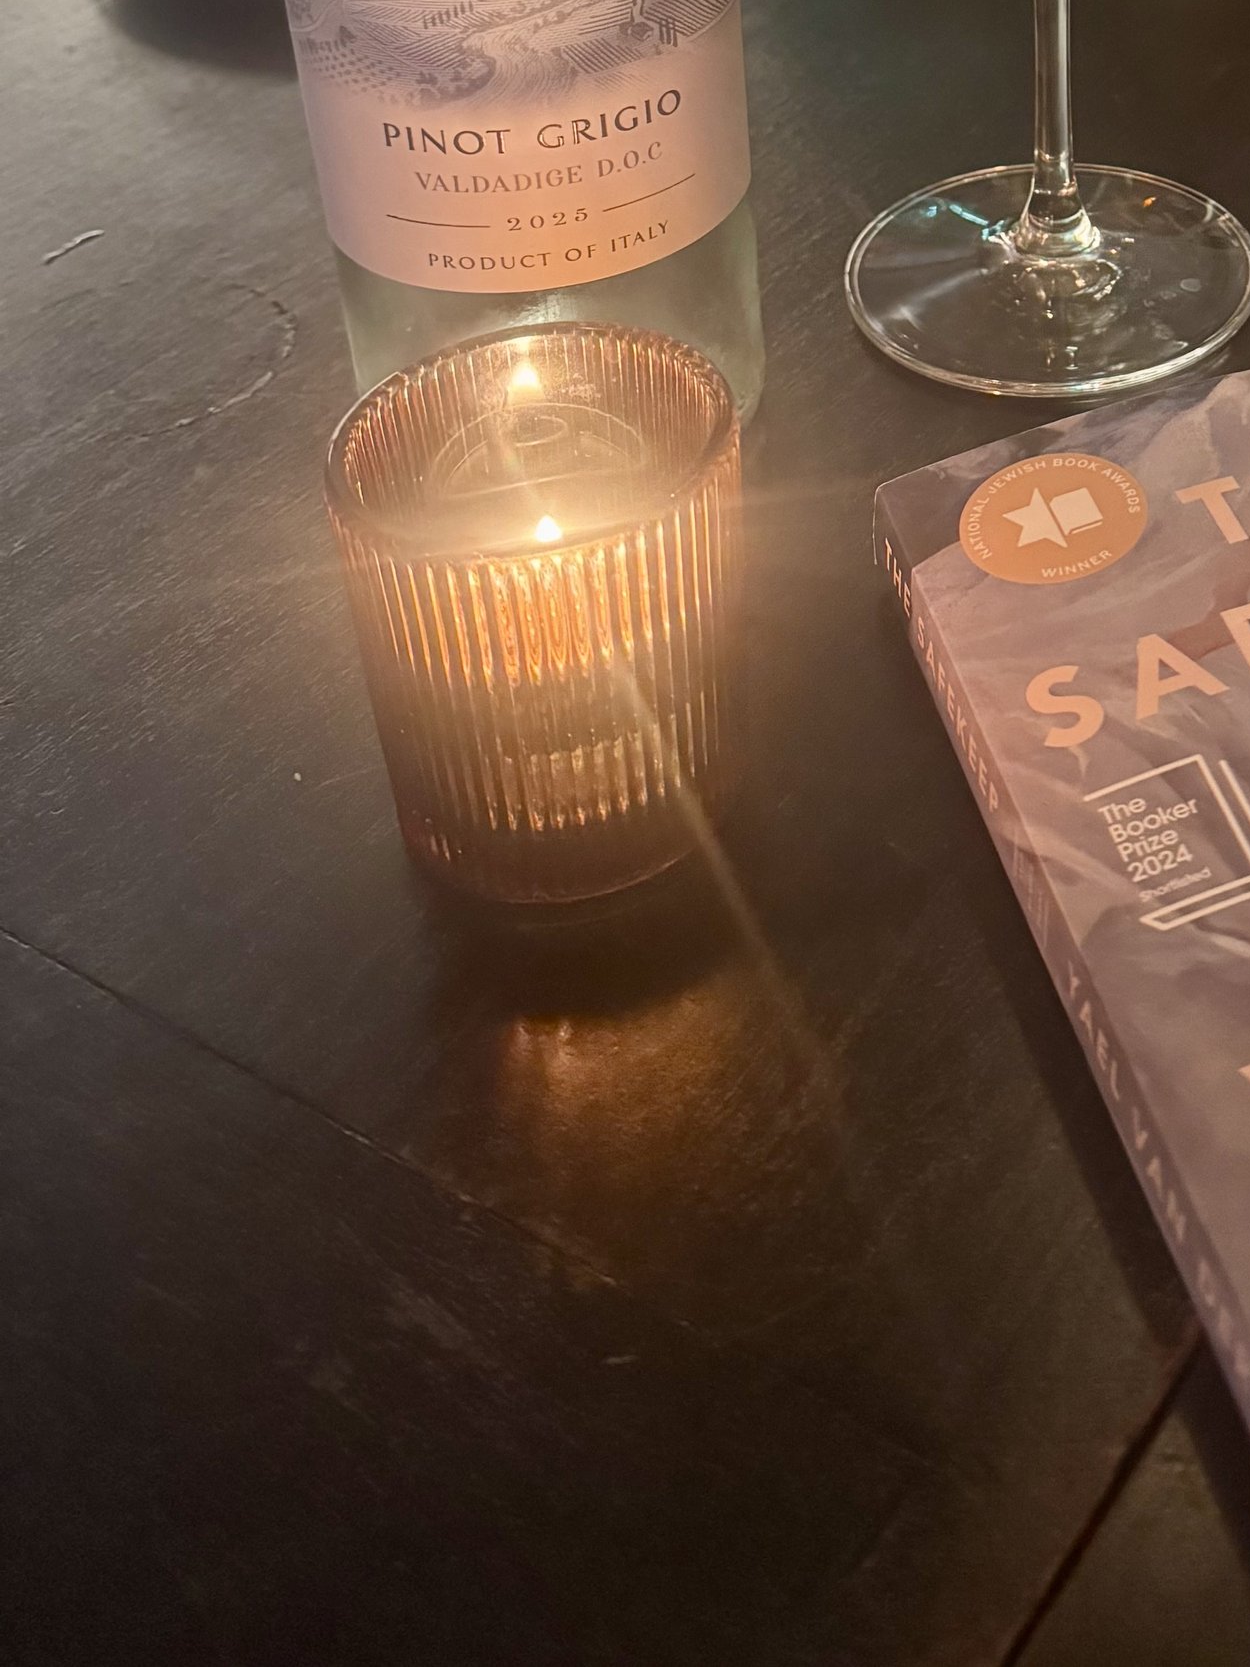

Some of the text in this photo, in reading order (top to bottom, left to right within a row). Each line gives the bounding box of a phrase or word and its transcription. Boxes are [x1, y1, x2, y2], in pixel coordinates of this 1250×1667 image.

[383, 89, 681, 155] PINOT GRIGIO
[414, 165, 583, 193] VALDADIGE
[507, 207, 588, 231] 2025
[428, 220, 669, 271] PRODUCT OF ITALY
[968, 458, 1141, 560] NATIONAL JEWISH BOOK AWARDS
[1041, 549, 1113, 578] WINNER
[884, 537, 911, 618] THE
[917, 616, 998, 813] SAFEKEEP
[1097, 797, 1147, 823] The
[1108, 798, 1200, 844] Booker
[1116, 829, 1180, 862] Prize
[1127, 844, 1193, 882] 2024
